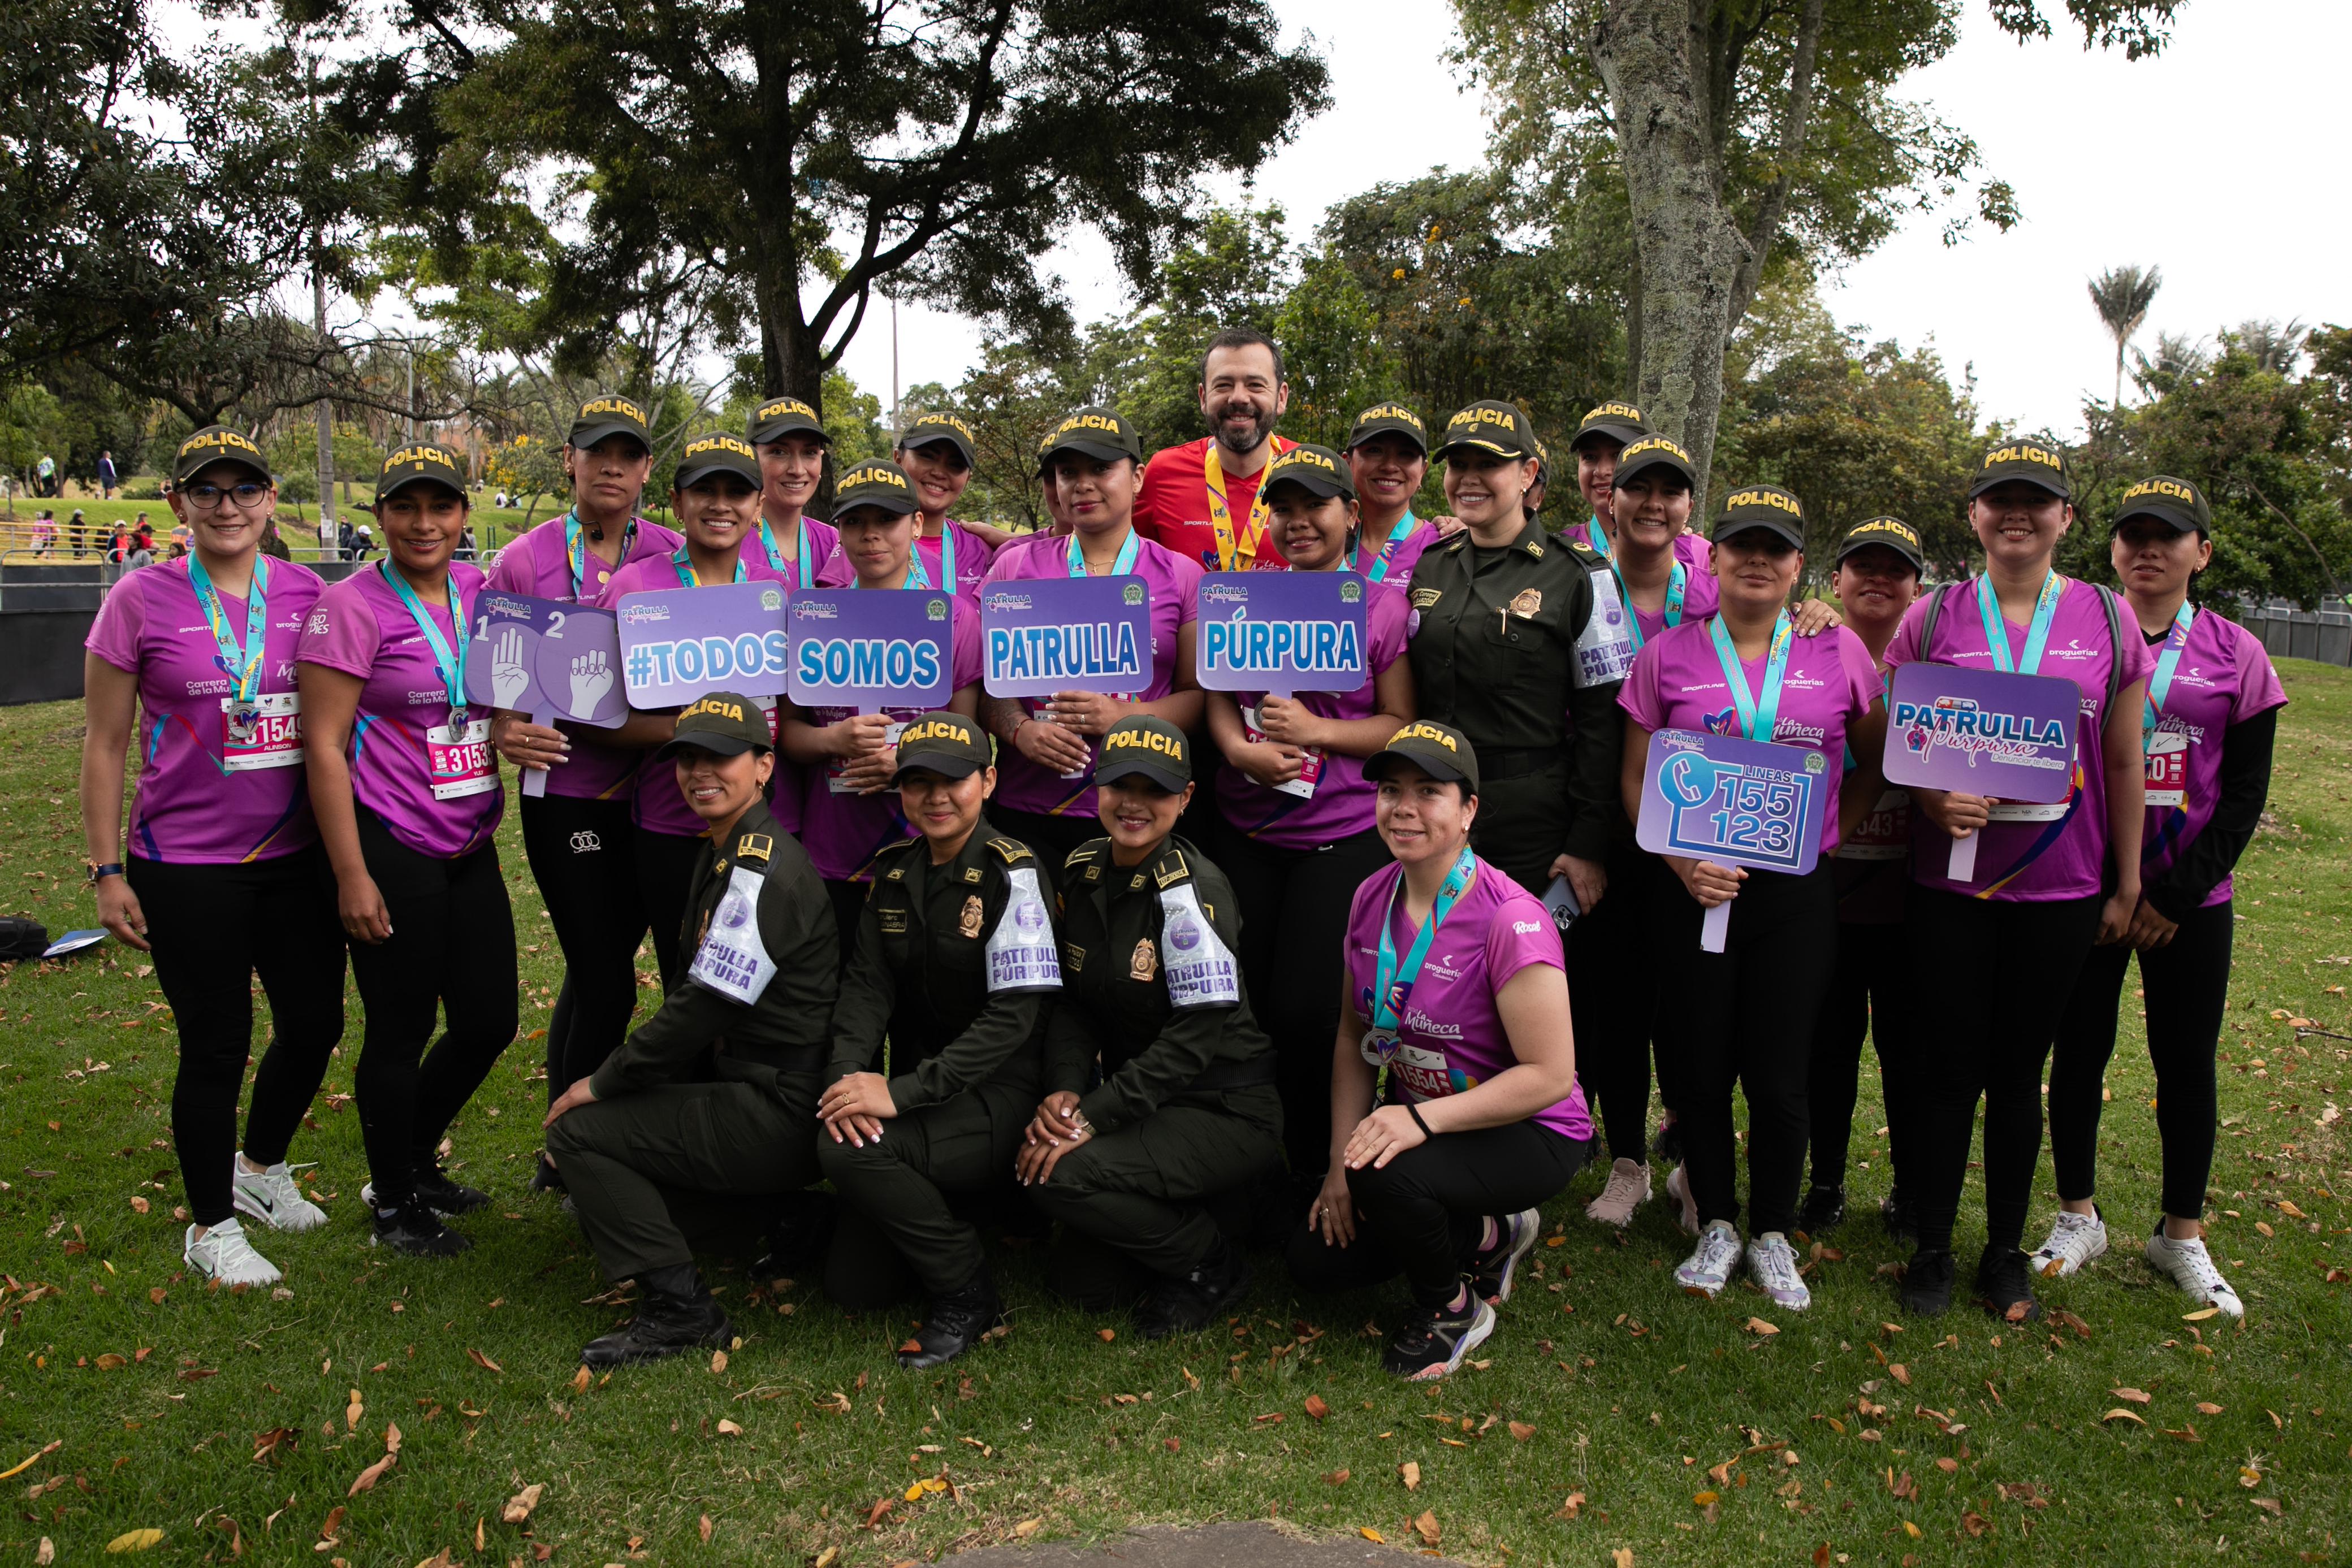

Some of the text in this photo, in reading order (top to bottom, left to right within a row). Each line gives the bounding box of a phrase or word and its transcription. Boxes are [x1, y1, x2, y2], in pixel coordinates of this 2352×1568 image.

[582, 400, 646, 428] POLICIA
[759, 401, 818, 423] POLICIA
[1360, 406, 1424, 430] POLICIA
[1447, 408, 1515, 432] POLICIA
[1581, 404, 1640, 426] POLICIA
[916, 414, 975, 444] POLICIA
[1056, 415, 1119, 440] POLICIA
[181, 431, 261, 457] POLICIA
[686, 438, 755, 460] POLICIA
[1622, 438, 1690, 464] POLICIA
[384, 446, 455, 473] POLICIA
[1270, 451, 1335, 474] POLICIA
[1984, 447, 2061, 470] POLICIA
[837, 469, 907, 495] POLICIA
[2120, 480, 2193, 504] POLICIA
[1727, 491, 1801, 517] POLICIA
[1849, 521, 1918, 546] POLICIA
[985, 595, 1031, 605] PATRULLA
[1202, 586, 1247, 595] PATRULLA
[2050, 591, 2059, 603] 5K
[486, 597, 531, 613] PATRULLA
[621, 605, 669, 618] PATRULLA
[792, 603, 837, 613] PATRULLA
[475, 615, 489, 642] 1
[546, 611, 565, 639] 2
[402, 636, 427, 645] SPORT
[1204, 605, 1361, 673] PÚRPURA
[626, 630, 788, 688] #TODOS
[988, 622, 1140, 681] PATRULLA
[1780, 647, 1788, 657] 5K
[244, 668, 252, 681] 5K
[797, 638, 940, 689] SOMOS
[186, 680, 227, 689] Carrera
[188, 687, 201, 696] de
[214, 685, 232, 695] Muj
[408, 690, 445, 699] Carrera
[1681, 683, 1726, 692] SPORTLINE
[433, 694, 448, 704] Muj
[825, 709, 847, 719] Mujer
[1782, 717, 1795, 726] La
[1896, 702, 2066, 748] PATRULLA
[2168, 713, 2180, 724] La
[900, 721, 971, 749] POLICIA
[1106, 730, 1182, 761] POLICIA
[1659, 732, 1704, 746] PATRULLA
[1923, 716, 2037, 767] Púrpura
[263, 743, 292, 752] ALINSON
[1992, 753, 2032, 765] Denunciar
[2042, 758, 2064, 769] libera
[1745, 765, 1792, 783] LINEAS
[1719, 777, 1794, 818] 155
[1710, 810, 1792, 854] 123
[1512, 920, 1541, 935] Rosal
[992, 946, 1058, 967] PATRULL
[1361, 947, 1380, 956] SPORTL
[993, 965, 1061, 984] PÚRPUR
[1166, 961, 1231, 985] ATRULLA
[1424, 962, 1462, 978] Droguería
[1169, 978, 1235, 1000] ÚRPURA
[1404, 1012, 1460, 1034] Muñeca
[1416, 1010, 1426, 1021] La
